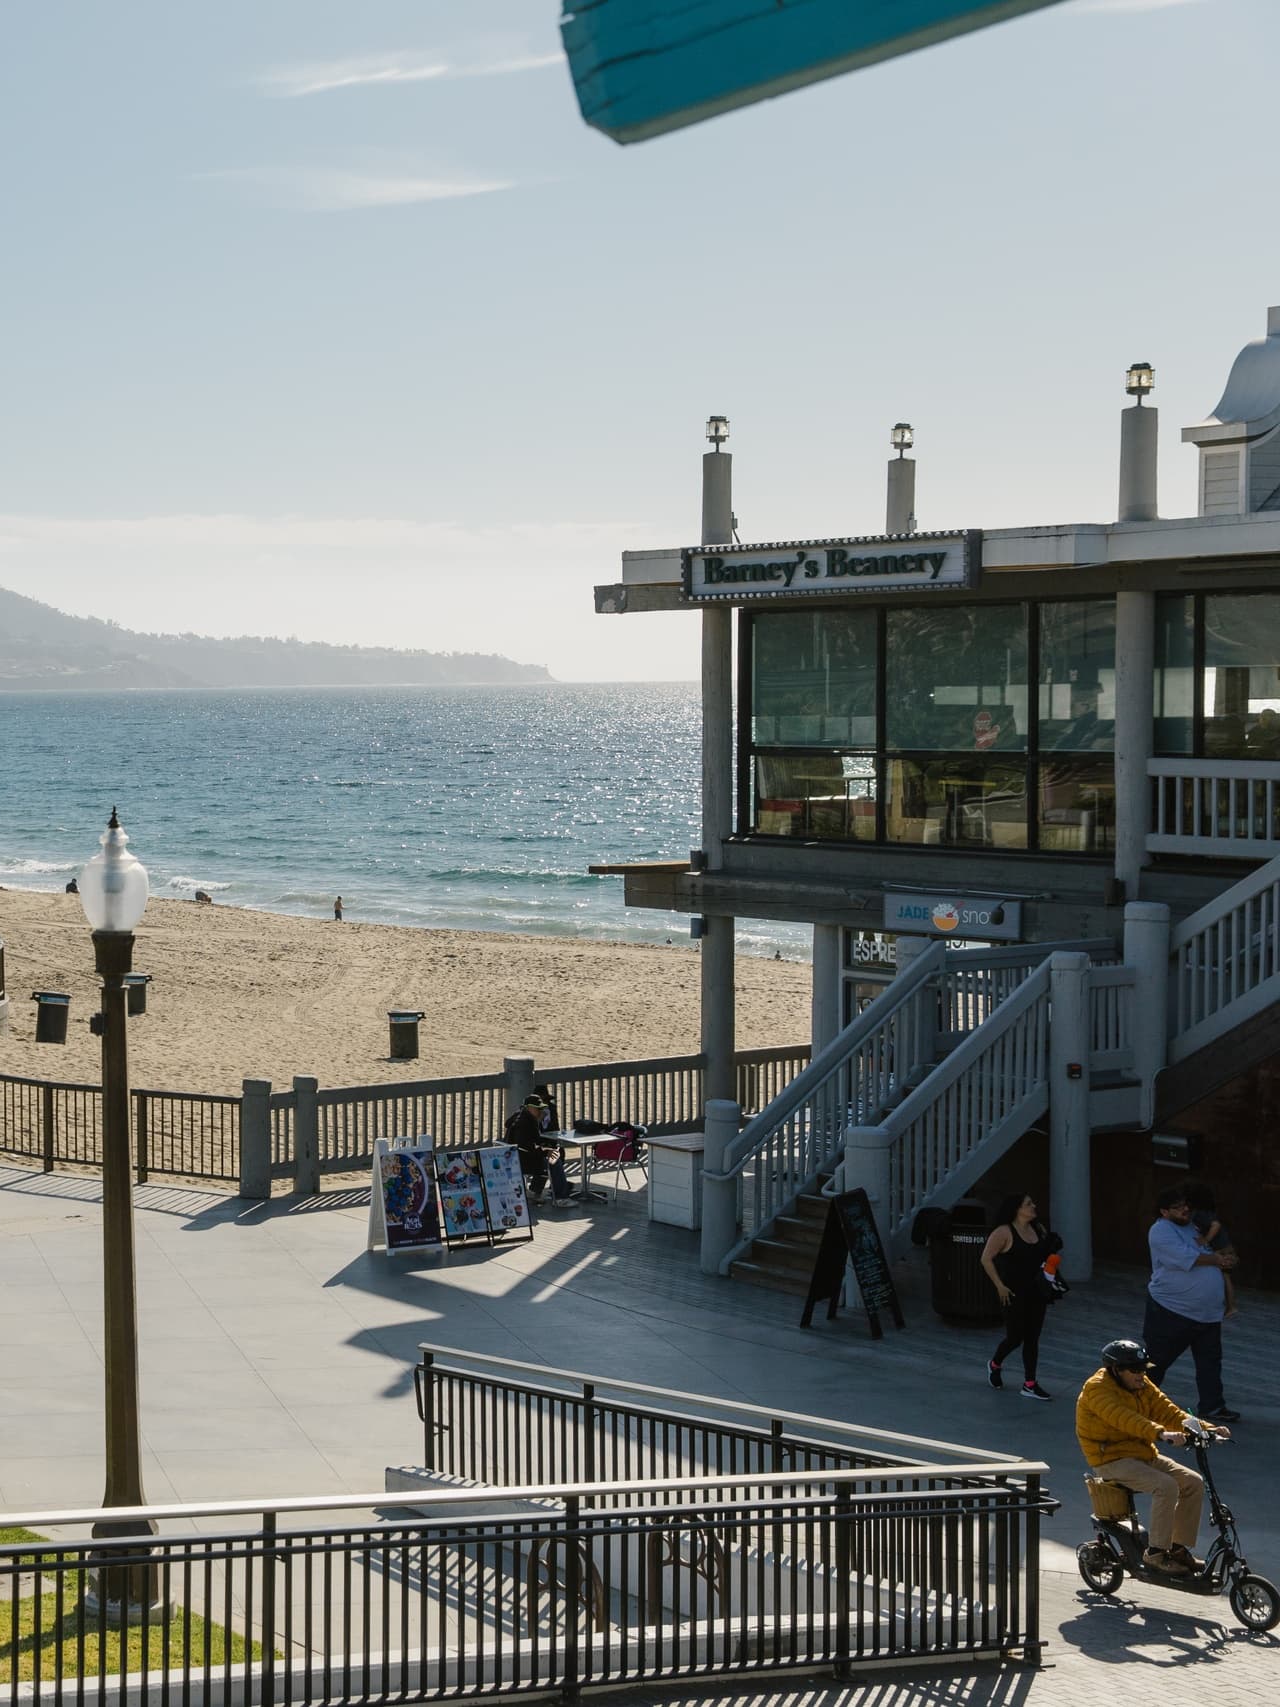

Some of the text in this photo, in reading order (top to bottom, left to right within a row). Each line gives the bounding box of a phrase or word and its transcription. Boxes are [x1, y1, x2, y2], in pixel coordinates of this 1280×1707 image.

[702, 549, 947, 587] Barney's Beanery
[897, 905, 992, 925] JADE sno
[853, 940, 897, 963] ESPRE
